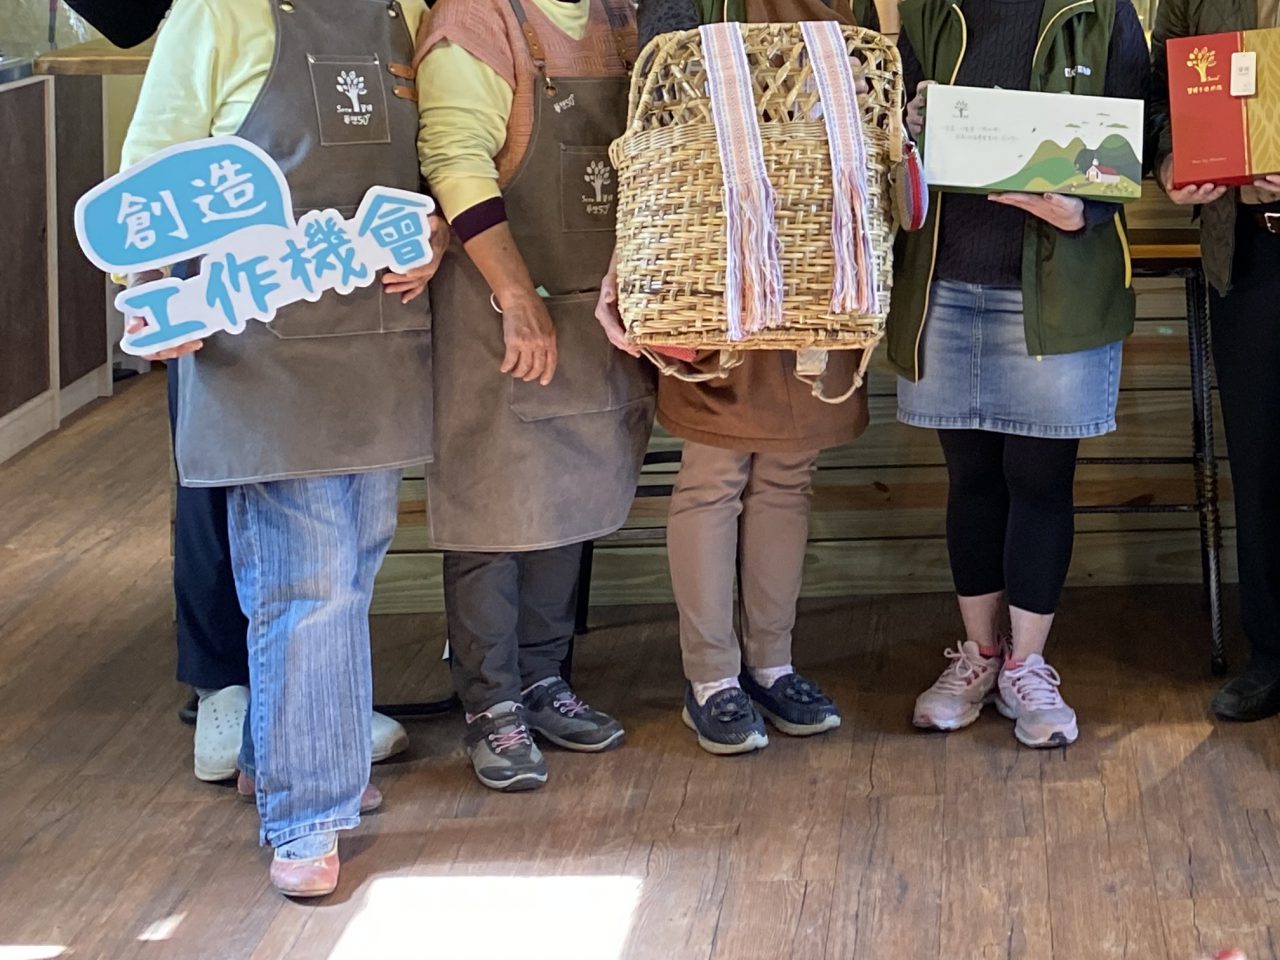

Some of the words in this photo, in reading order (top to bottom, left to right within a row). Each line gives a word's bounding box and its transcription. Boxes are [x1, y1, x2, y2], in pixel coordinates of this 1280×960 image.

[117, 159, 267, 250] 創造
[124, 194, 427, 347] 工作機會
